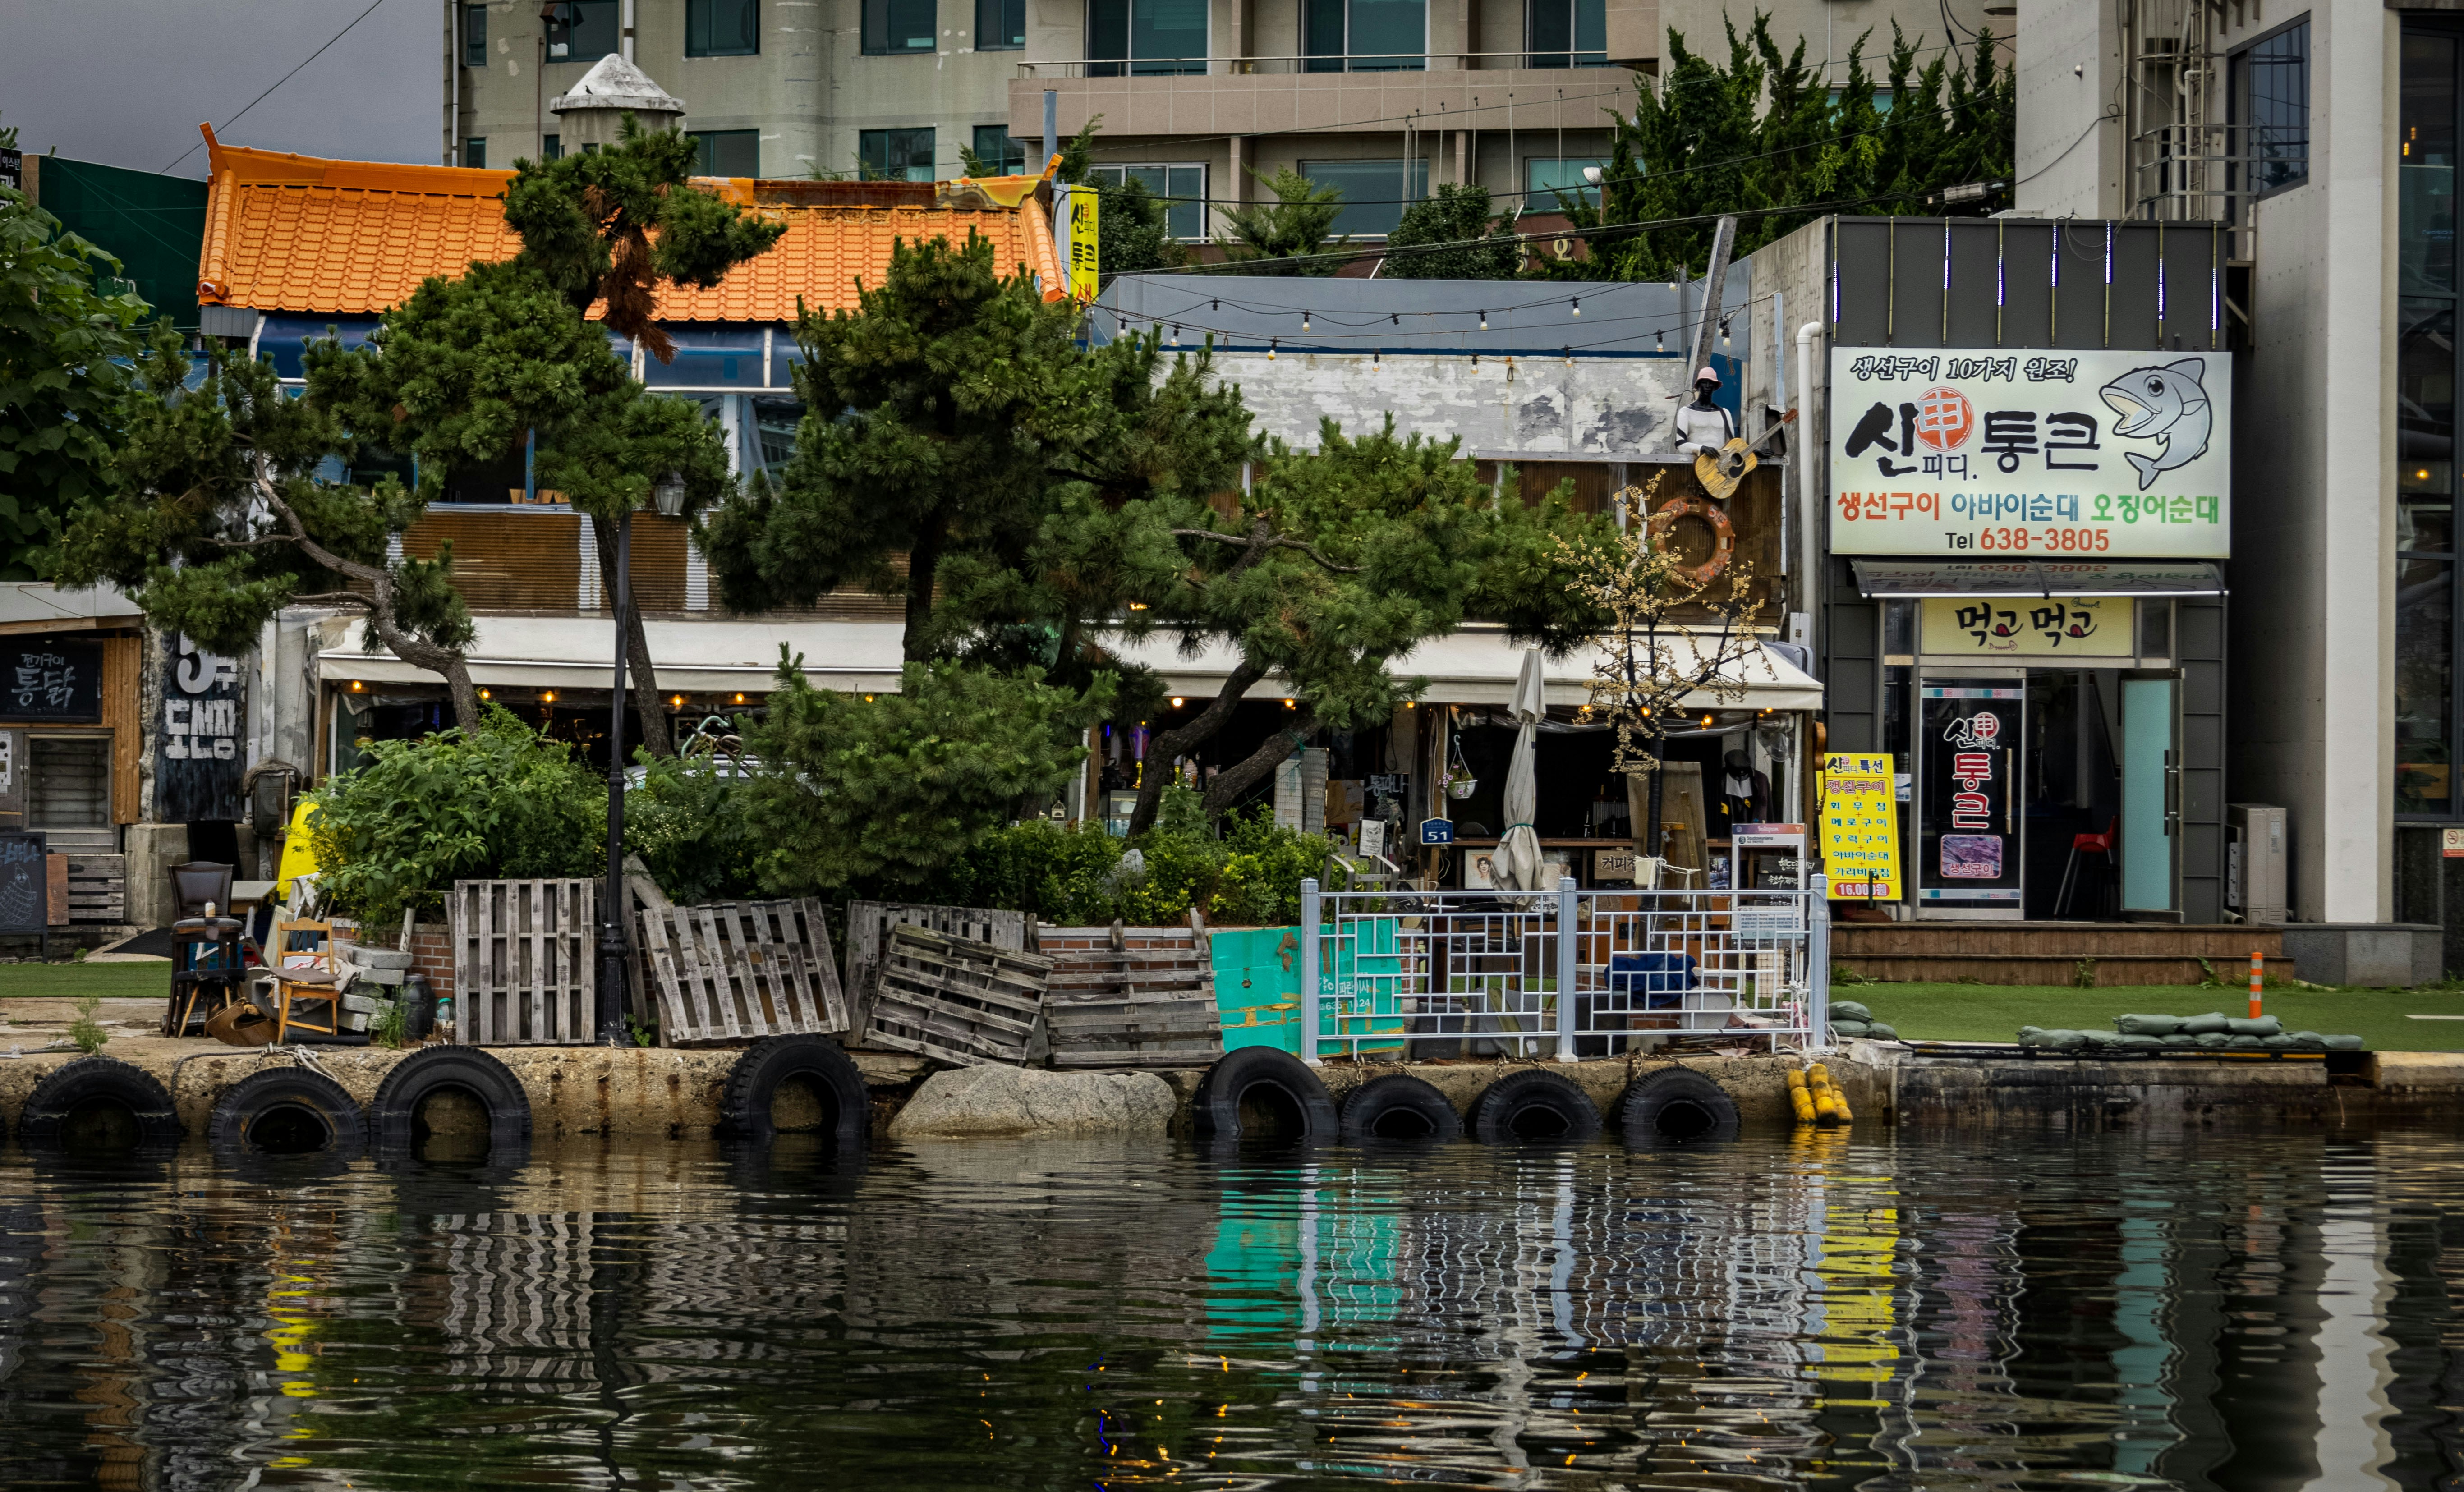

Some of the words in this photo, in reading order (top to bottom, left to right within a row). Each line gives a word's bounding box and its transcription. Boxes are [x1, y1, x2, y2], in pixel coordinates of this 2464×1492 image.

[1072, 242, 1096, 272] 통큰
[1851, 357, 1938, 381] 생선구이
[1947, 358, 2017, 381] 10가지
[2024, 358, 2078, 382] 원조!
[1981, 411, 2100, 473] 통큰
[1838, 492, 1940, 521] 생선구이
[1951, 493, 2079, 521] 아바이순대
[2090, 494, 2219, 523] 오징어순대
[1945, 532, 1974, 549] Tel
[1980, 528, 2109, 551] 638-3805
[21, 653, 64, 667] 전기구이
[11, 666, 76, 708] 통닭
[1859, 759, 1884, 774] 특선
[1825, 779, 1886, 795] 생선구이
[1952, 753, 1992, 829] 통큰
[1831, 818, 1887, 827] 메로구이
[1428, 831, 1447, 841] 51
[1832, 834, 1888, 844] 우럭구이
[1833, 851, 1889, 861] 아바이순대
[1949, 862, 1994, 875] 생선구이
